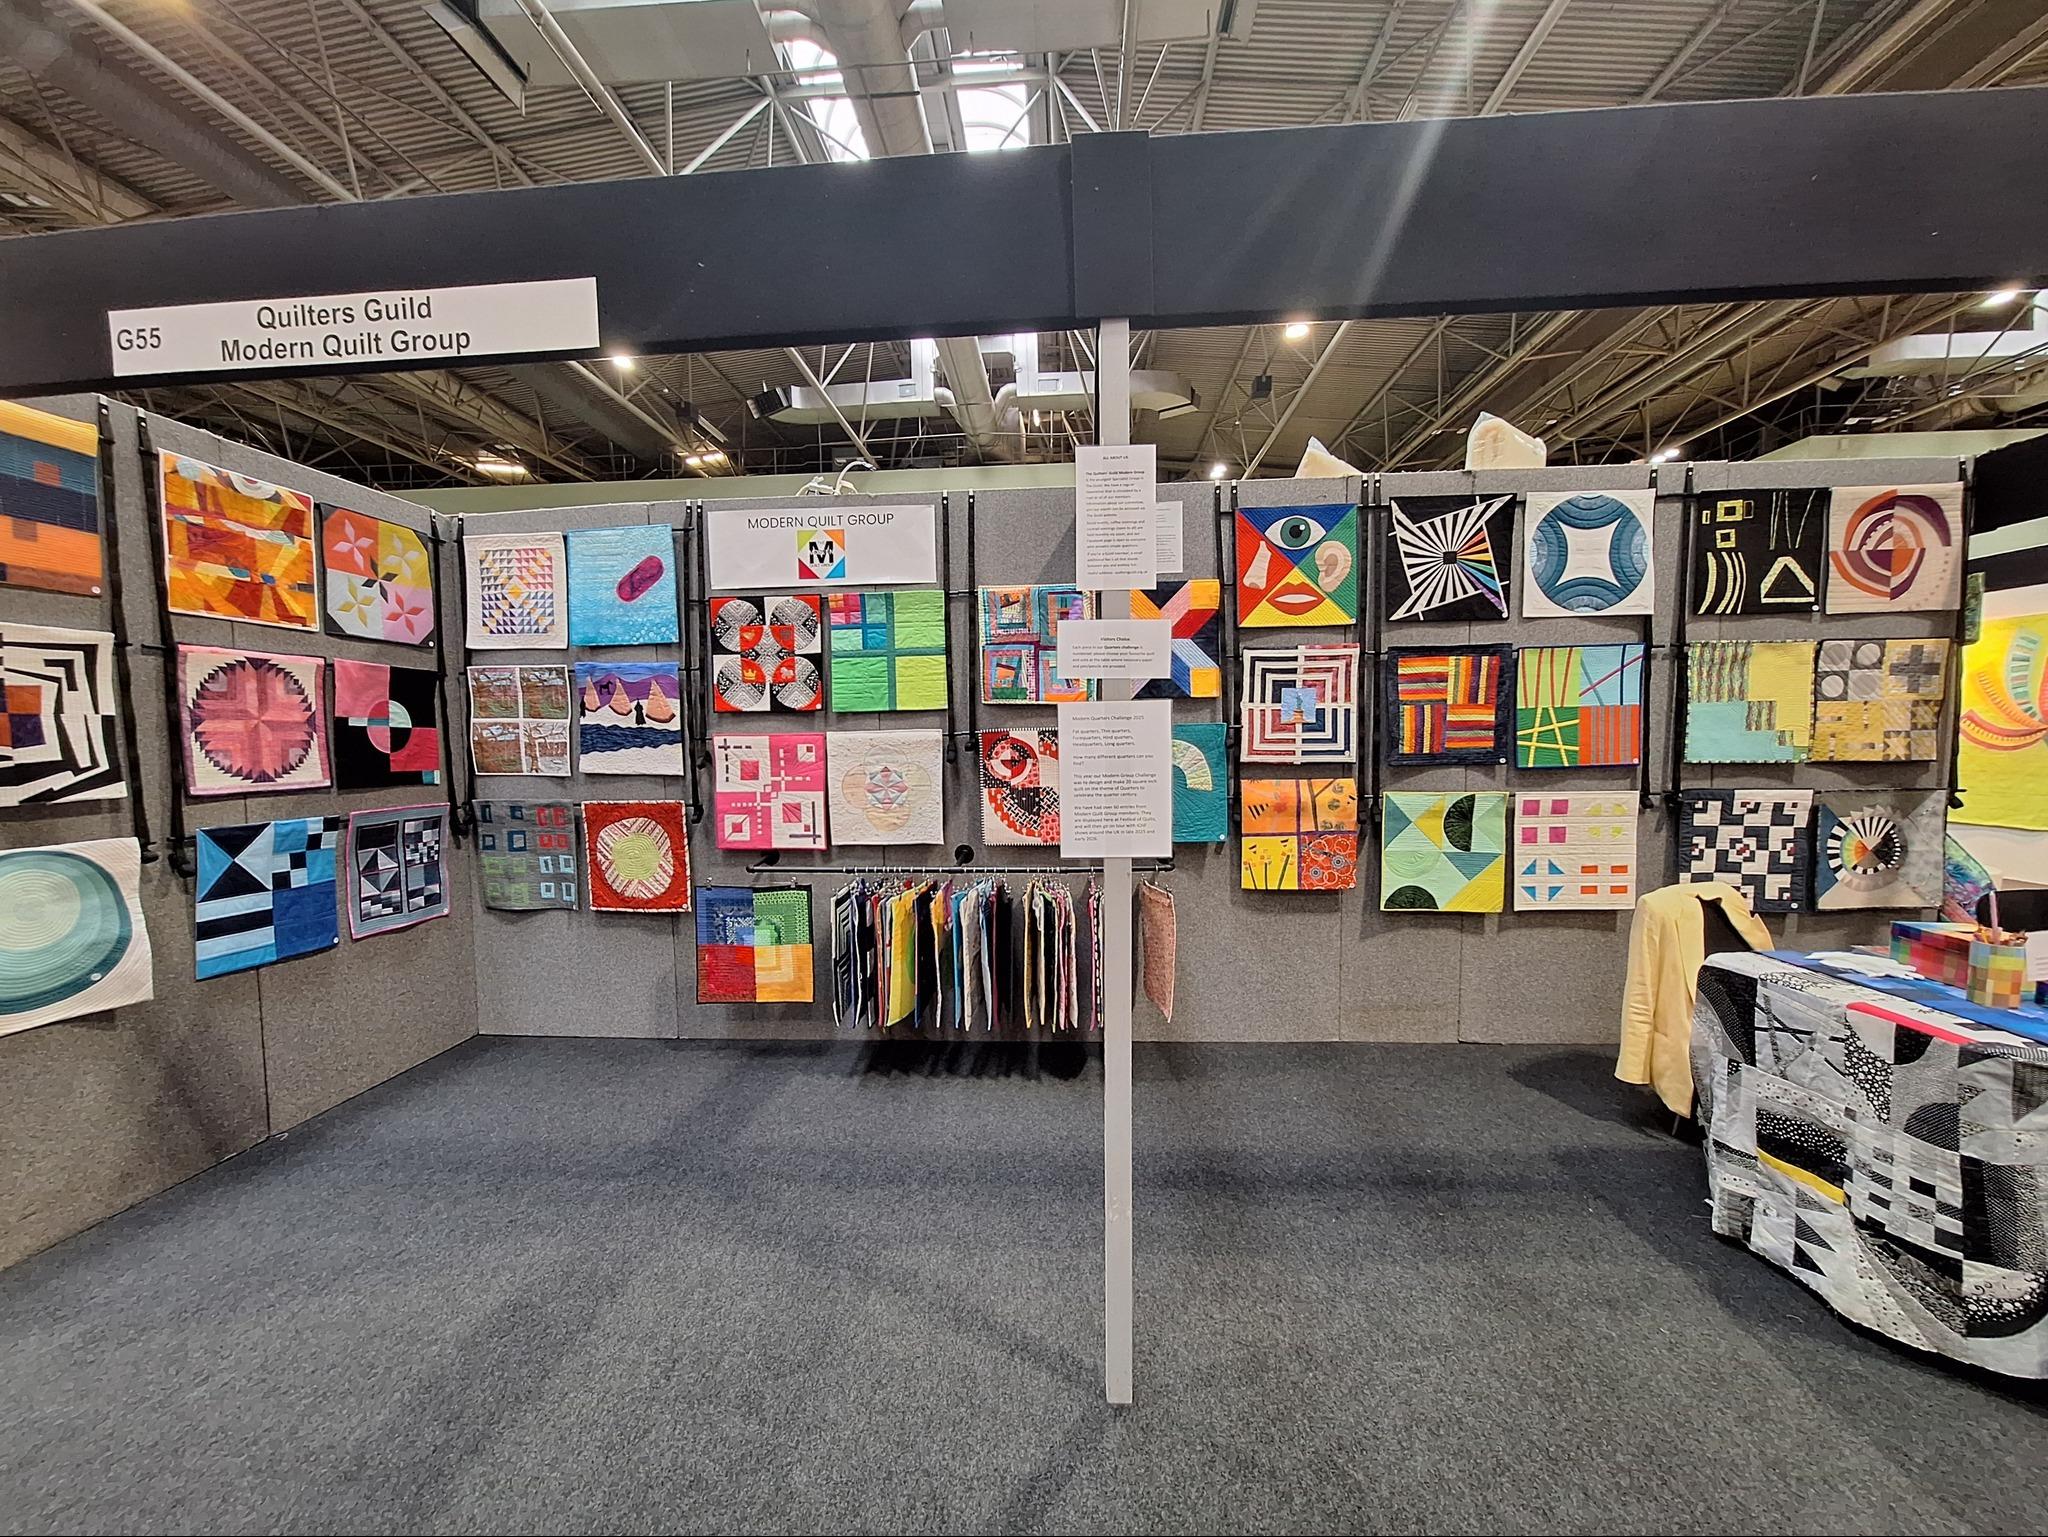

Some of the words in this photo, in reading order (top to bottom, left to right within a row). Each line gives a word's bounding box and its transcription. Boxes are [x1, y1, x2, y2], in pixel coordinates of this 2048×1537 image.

[256, 300, 355, 330] Quilters
[364, 296, 432, 321] Guild
[117, 327, 161, 351] G55
[221, 339, 314, 362] Modern
[323, 332, 382, 357] Quilt
[390, 328, 471, 354] Group
[748, 517, 803, 529] MODERN
[808, 515, 843, 528] QUILT
[848, 513, 894, 525] GROUP
